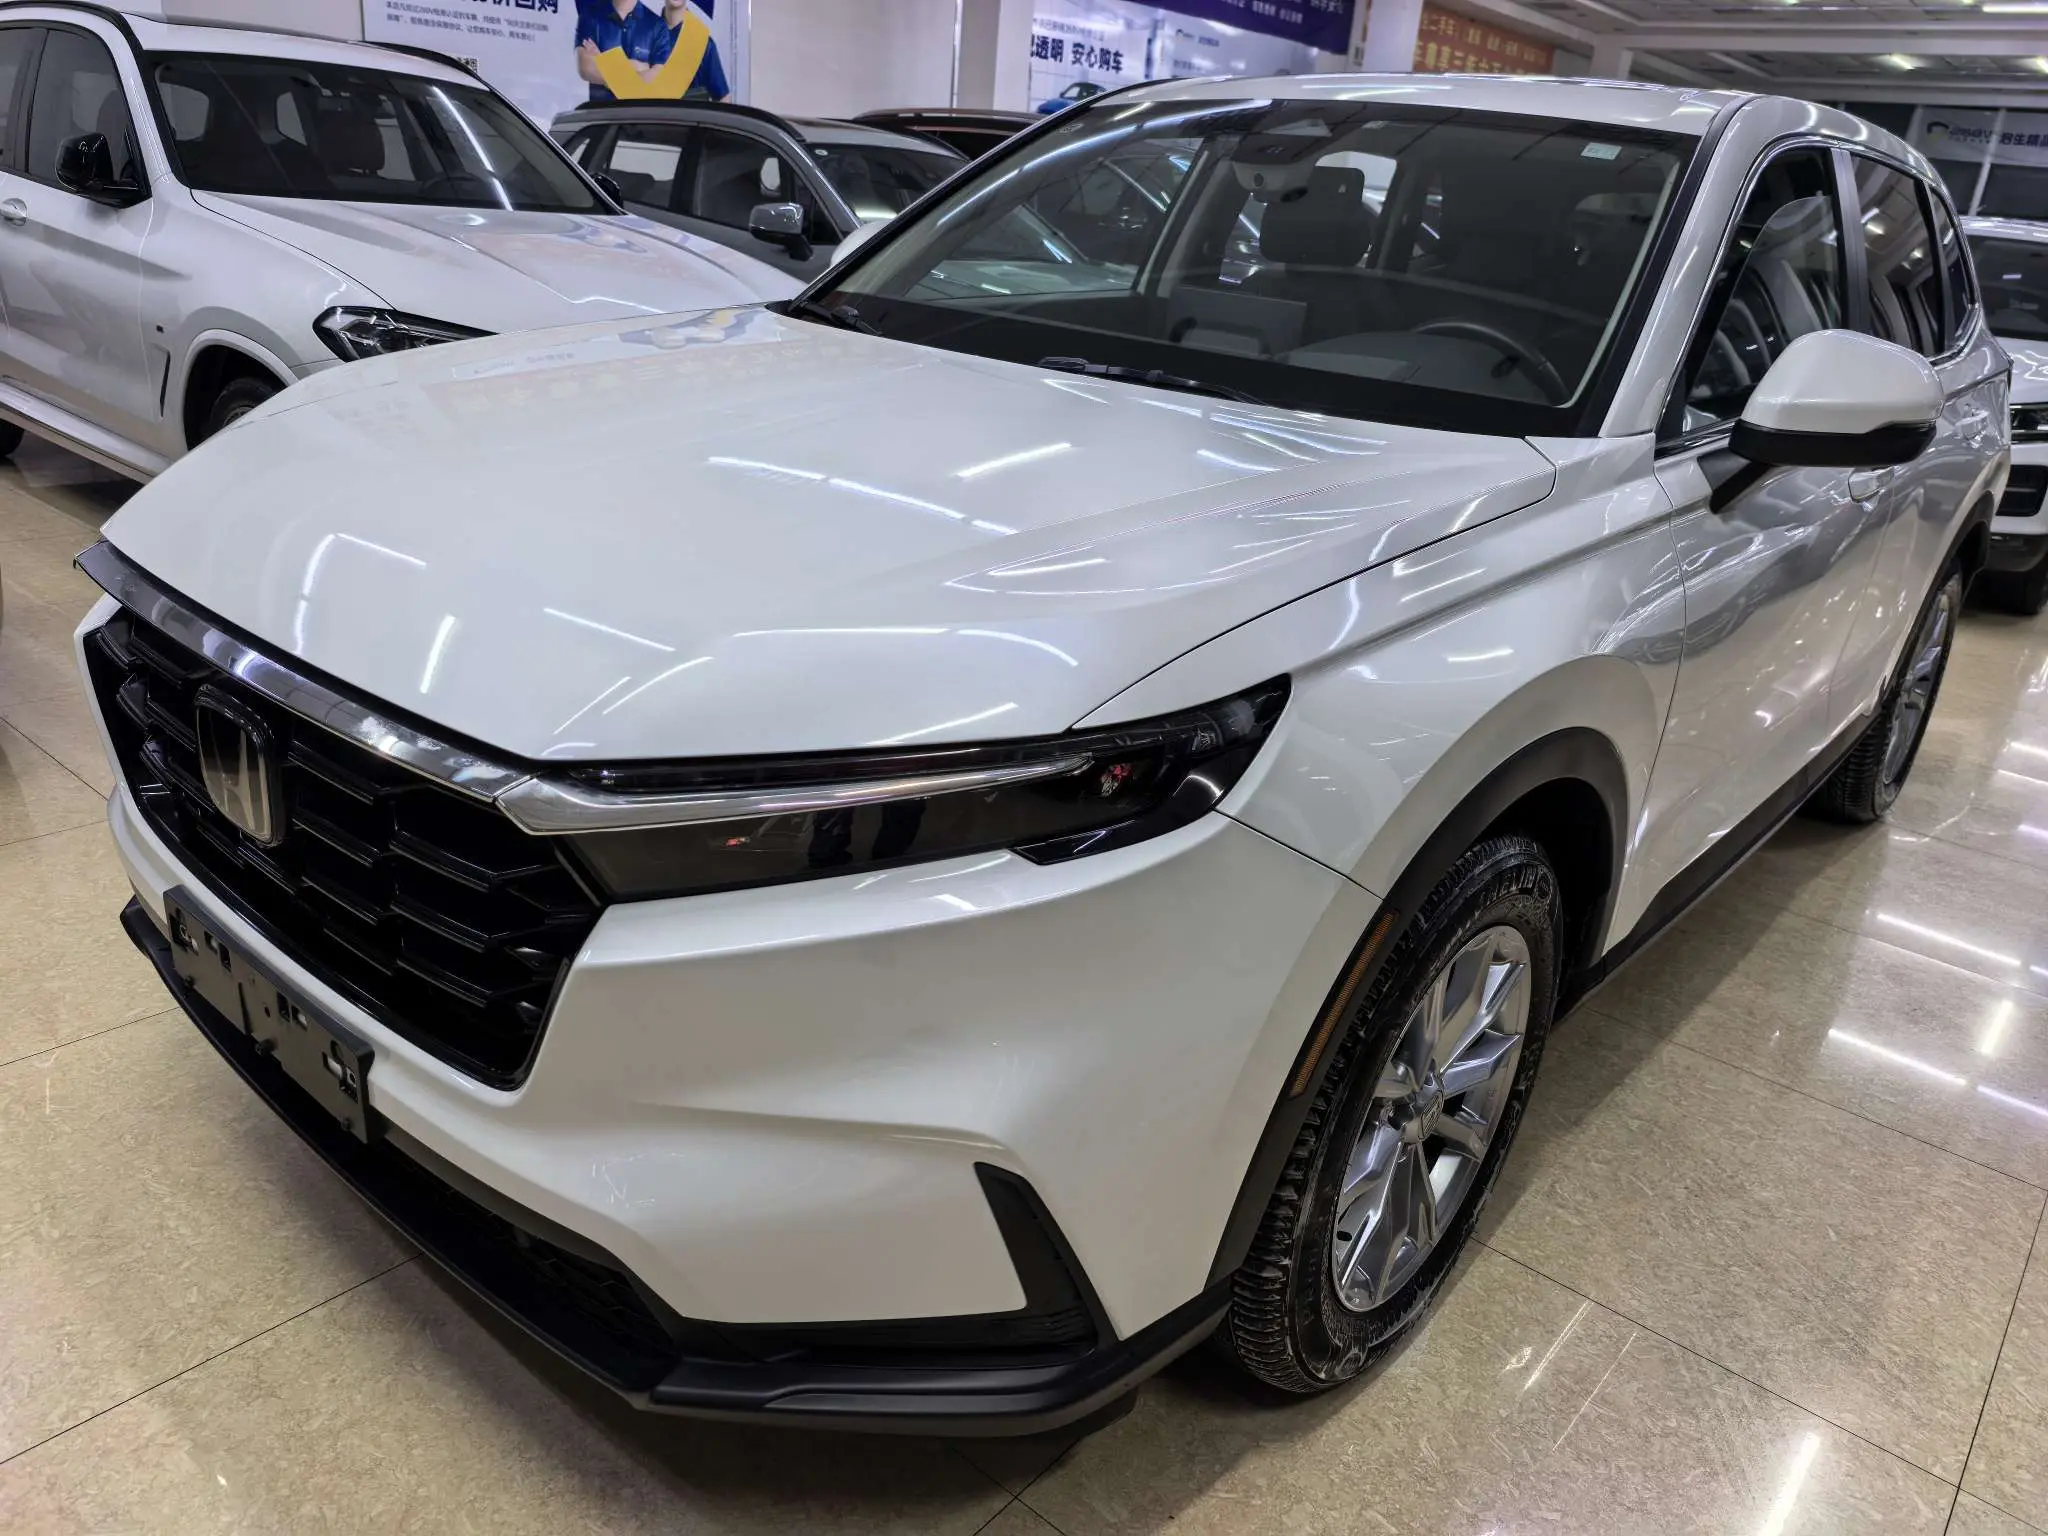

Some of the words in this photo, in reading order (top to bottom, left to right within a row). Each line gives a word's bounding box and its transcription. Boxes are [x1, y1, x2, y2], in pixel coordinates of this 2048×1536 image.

[1030, 33, 1064, 63] 透明
[1071, 42, 1124, 74] 安心购车
